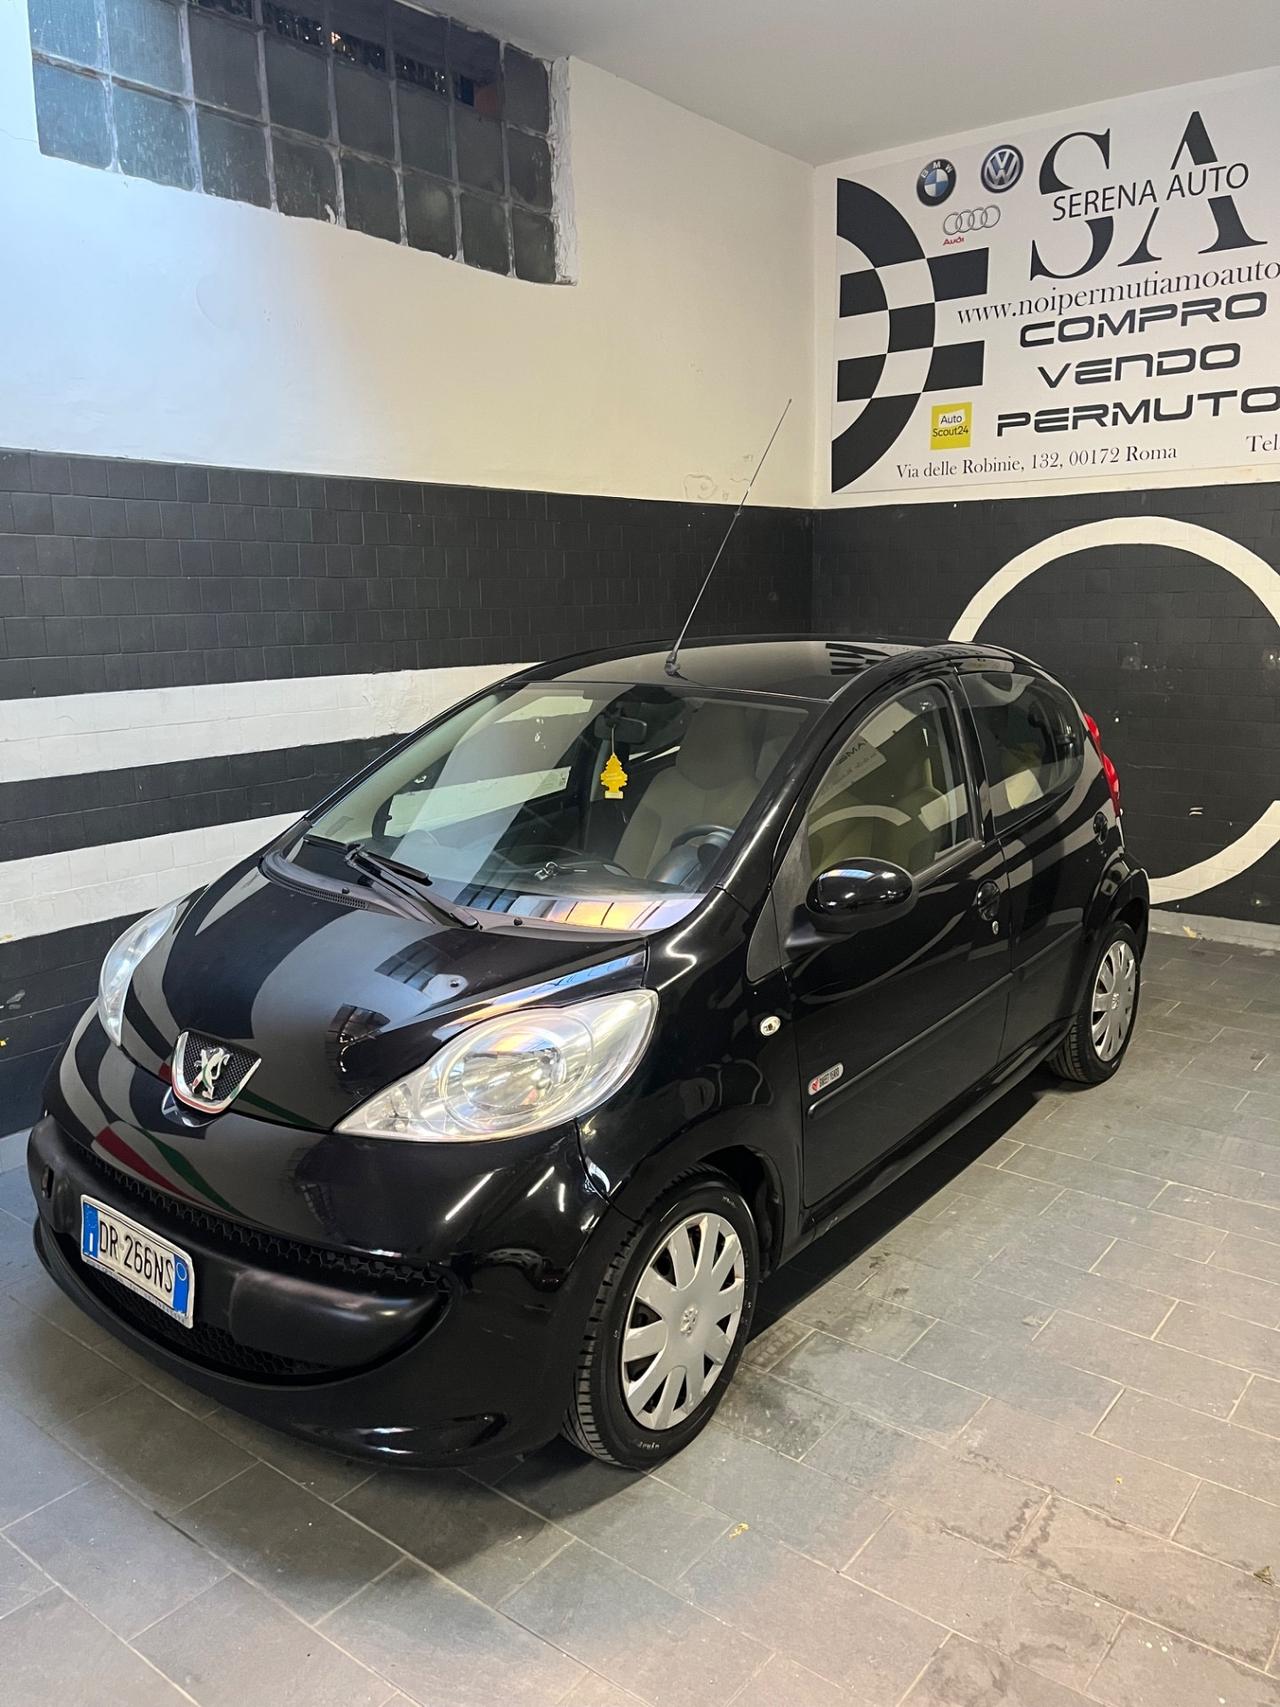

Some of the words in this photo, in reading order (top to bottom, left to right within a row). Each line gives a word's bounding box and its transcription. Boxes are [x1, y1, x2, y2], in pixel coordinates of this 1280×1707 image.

[920, 160, 954, 179] BMW
[1029, 110, 1268, 281] SA
[1052, 179, 1158, 221] SERENA
[1166, 163, 1249, 201] AUTO
[943, 236, 965, 246] Audi
[1019, 291, 1267, 348] COMPRO
[1037, 342, 1241, 388] VENDO
[940, 415, 963, 425] Auto
[997, 385, 1280, 437] PERMUTO
[932, 425, 969, 437] Scout24
[896, 464, 919, 478] Via
[923, 461, 957, 477] delle
[963, 456, 1025, 474] Robinie,
[1031, 451, 1063, 470] 132,
[1069, 447, 1120, 466] 00172
[1126, 445, 1177, 462] Roma
